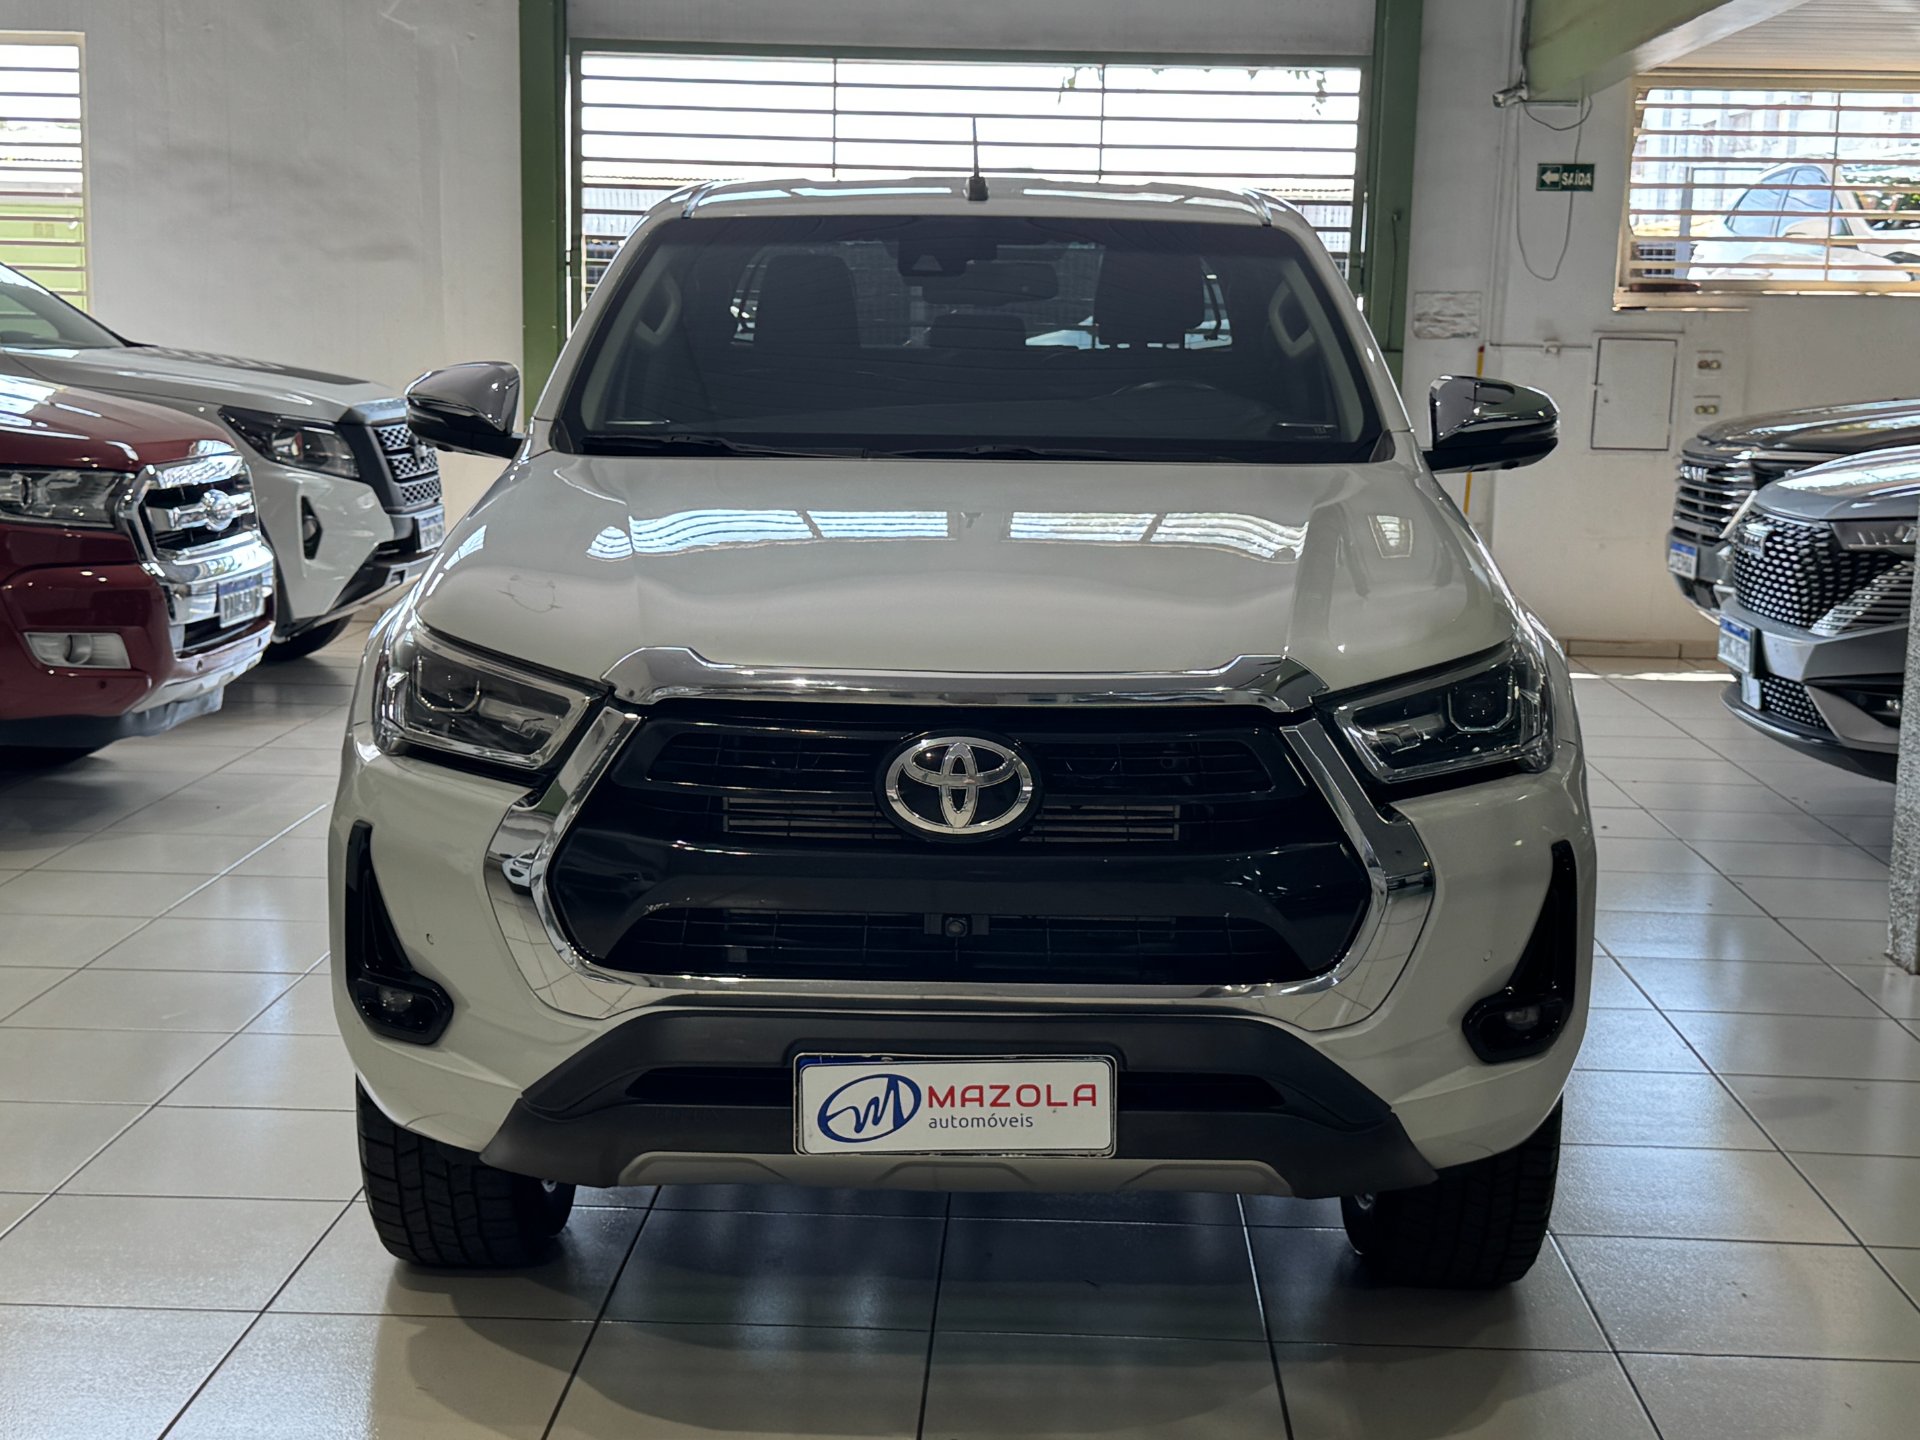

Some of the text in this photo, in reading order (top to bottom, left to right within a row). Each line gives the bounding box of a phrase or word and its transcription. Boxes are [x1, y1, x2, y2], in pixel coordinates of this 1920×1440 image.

[1561, 169, 1592, 186] SAÍDA
[928, 1083, 1097, 1108] MAZOLA
[928, 1112, 1034, 1129] automóveis
